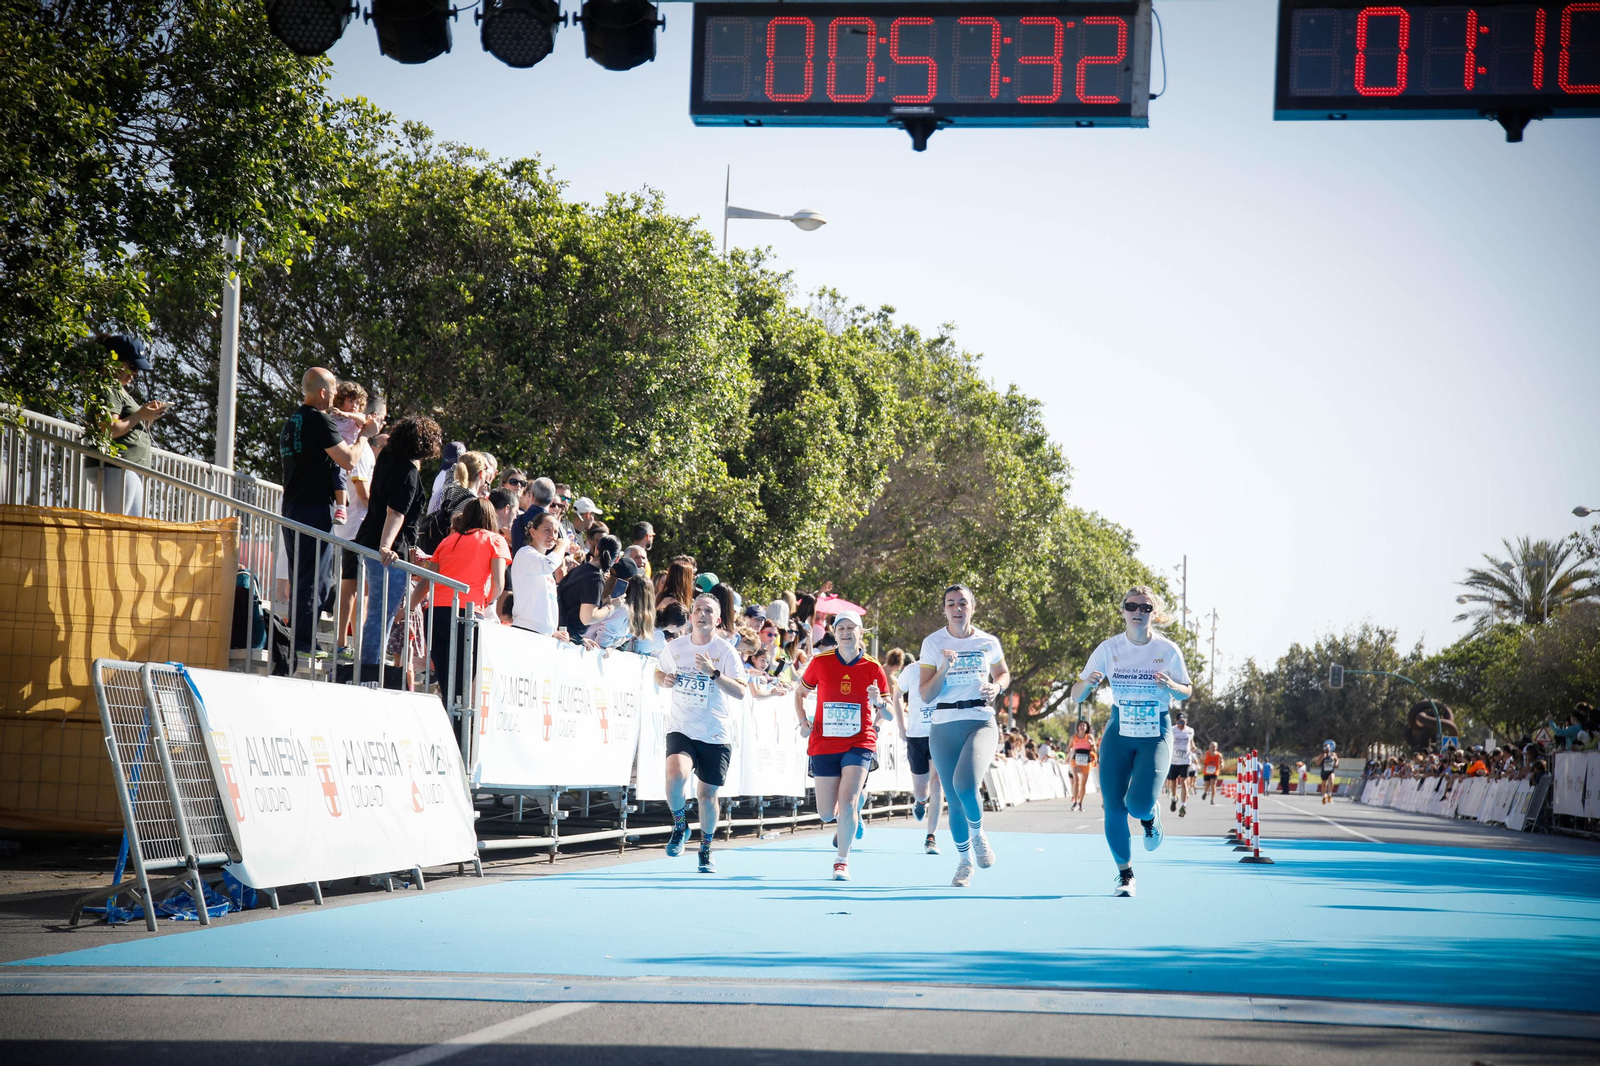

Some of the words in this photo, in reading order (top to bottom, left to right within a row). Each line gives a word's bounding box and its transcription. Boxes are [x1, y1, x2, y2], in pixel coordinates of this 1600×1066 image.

[677, 677, 706, 691] 5739
[827, 709, 857, 720] 5037
[1123, 706, 1156, 718] 5454
[245, 728, 311, 776] ALMERÍA
[254, 786, 292, 813] CIUDAD
